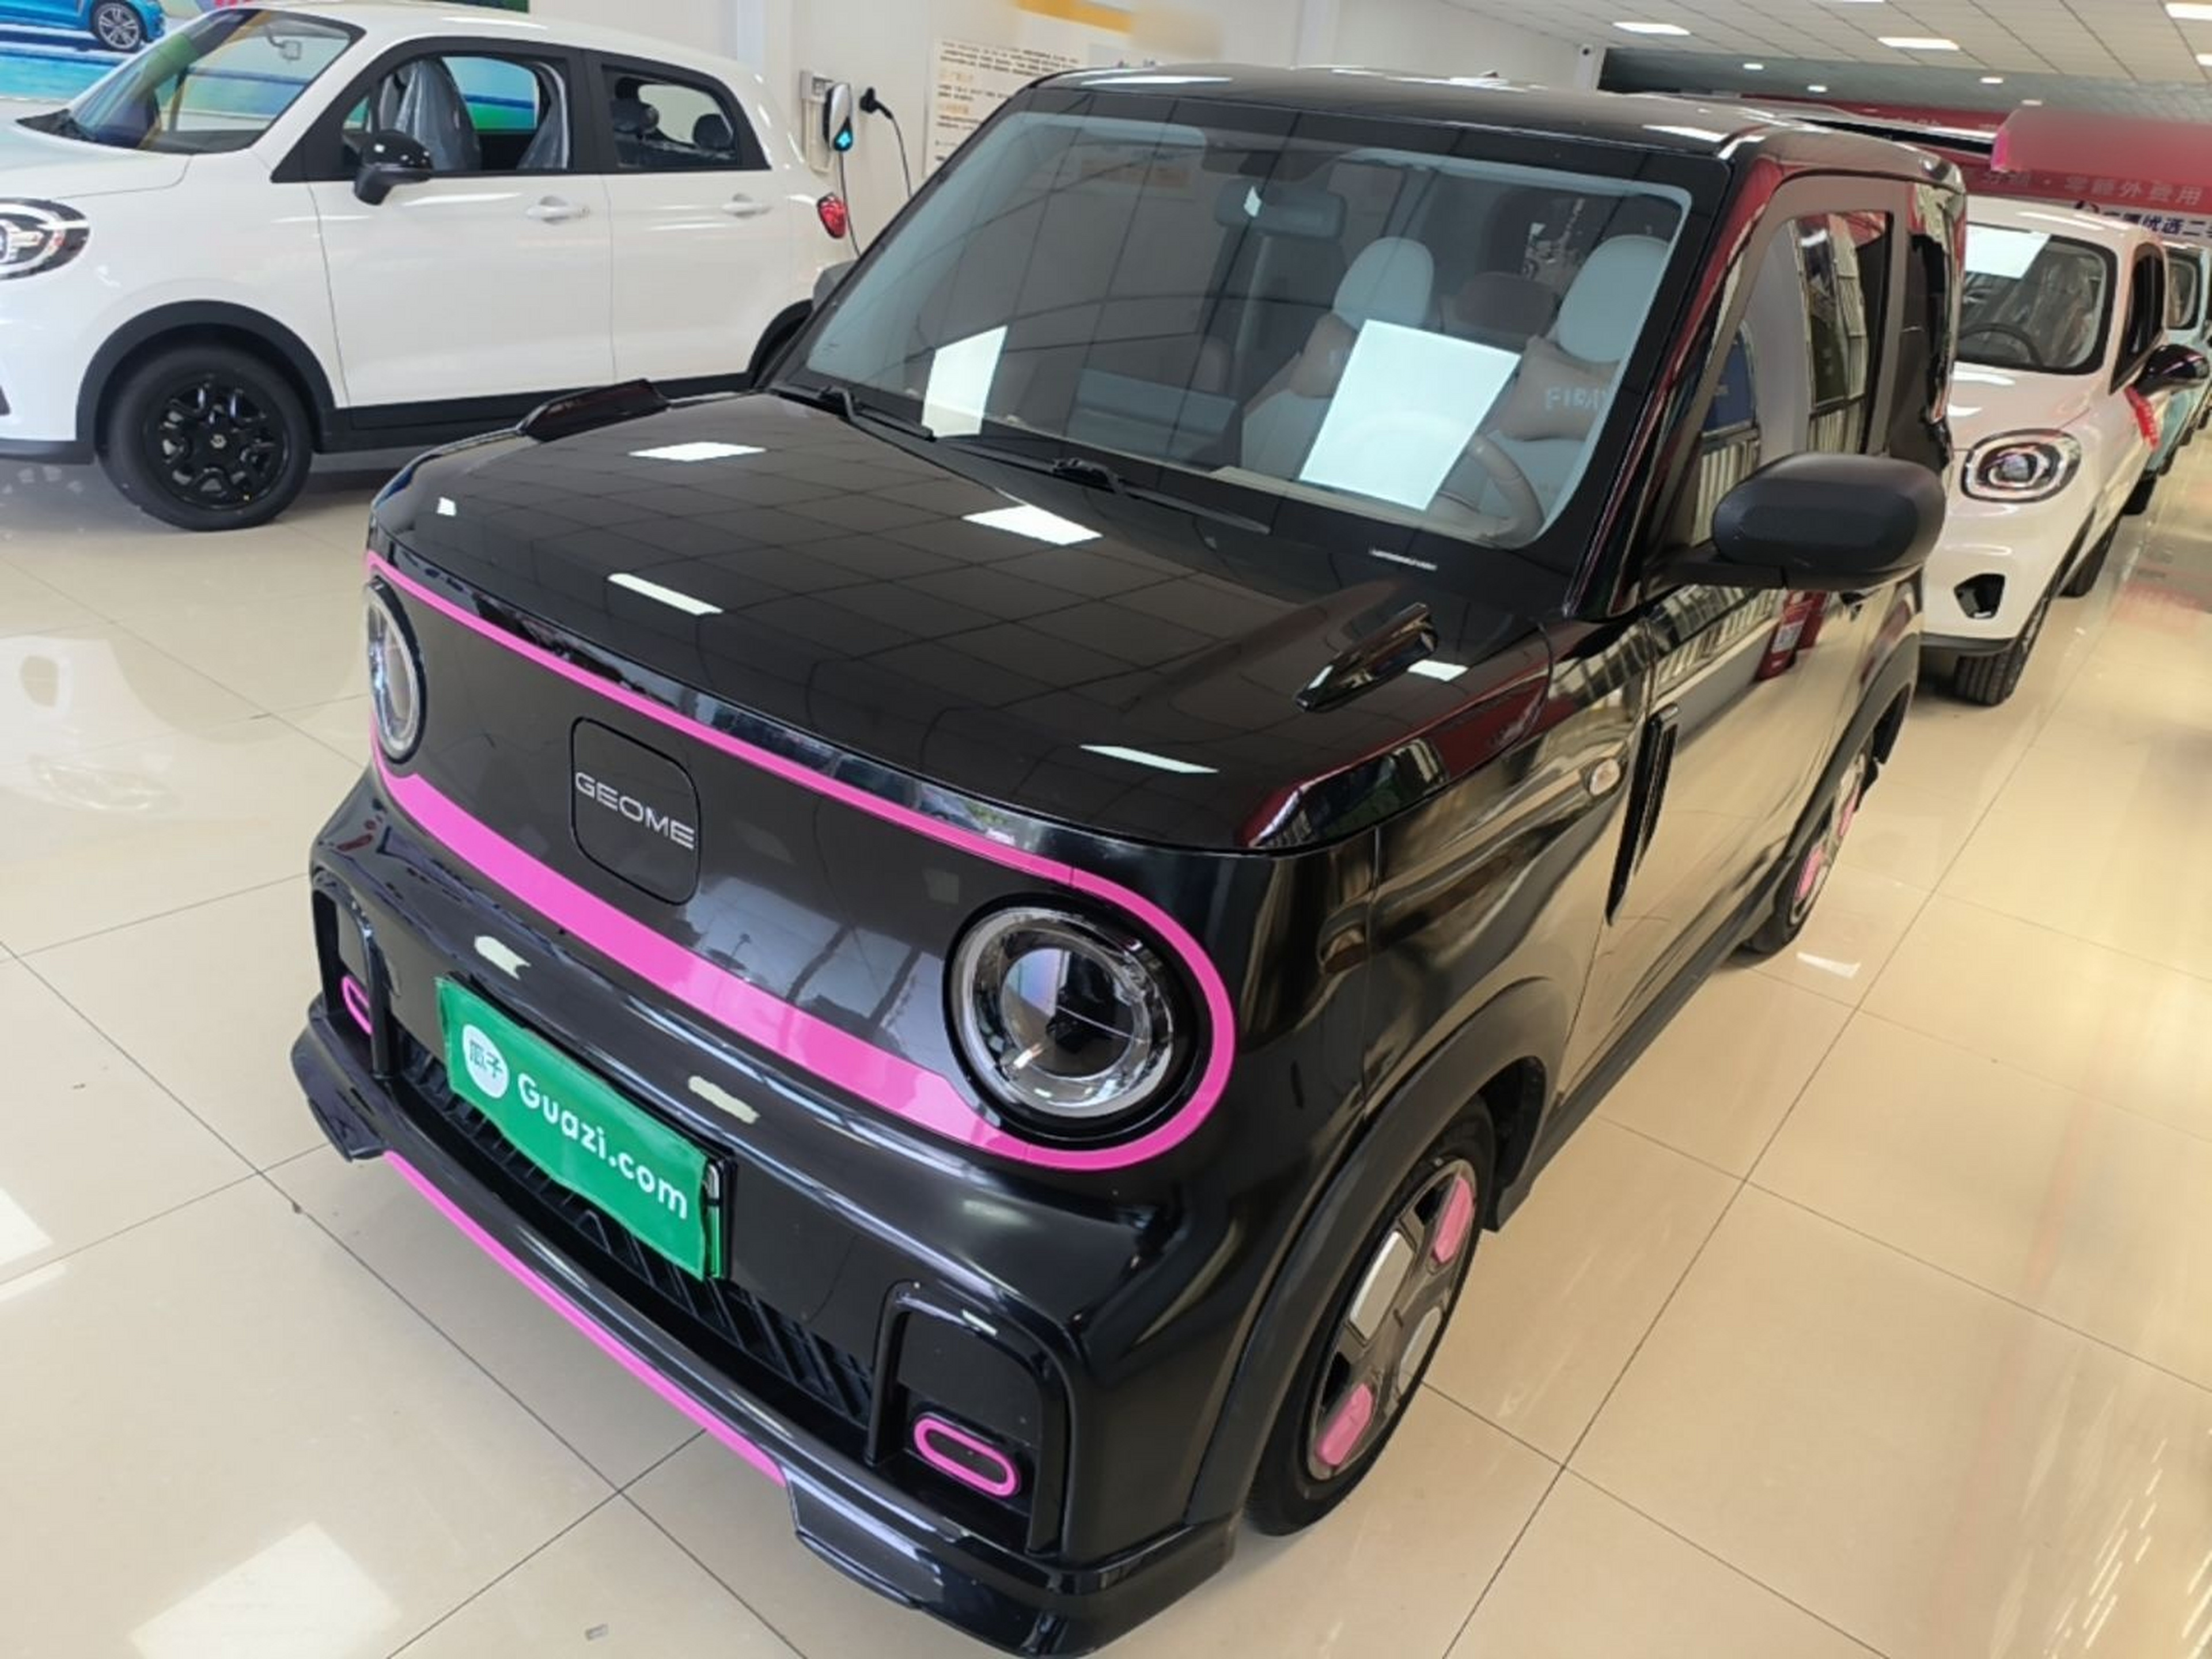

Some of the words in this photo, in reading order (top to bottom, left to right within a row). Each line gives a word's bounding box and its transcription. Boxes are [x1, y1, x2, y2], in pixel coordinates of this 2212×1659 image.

[575, 772, 695, 850] GEOME
[469, 1039, 503, 1078] 瓜子
[518, 1073, 687, 1219] Guazi.com
